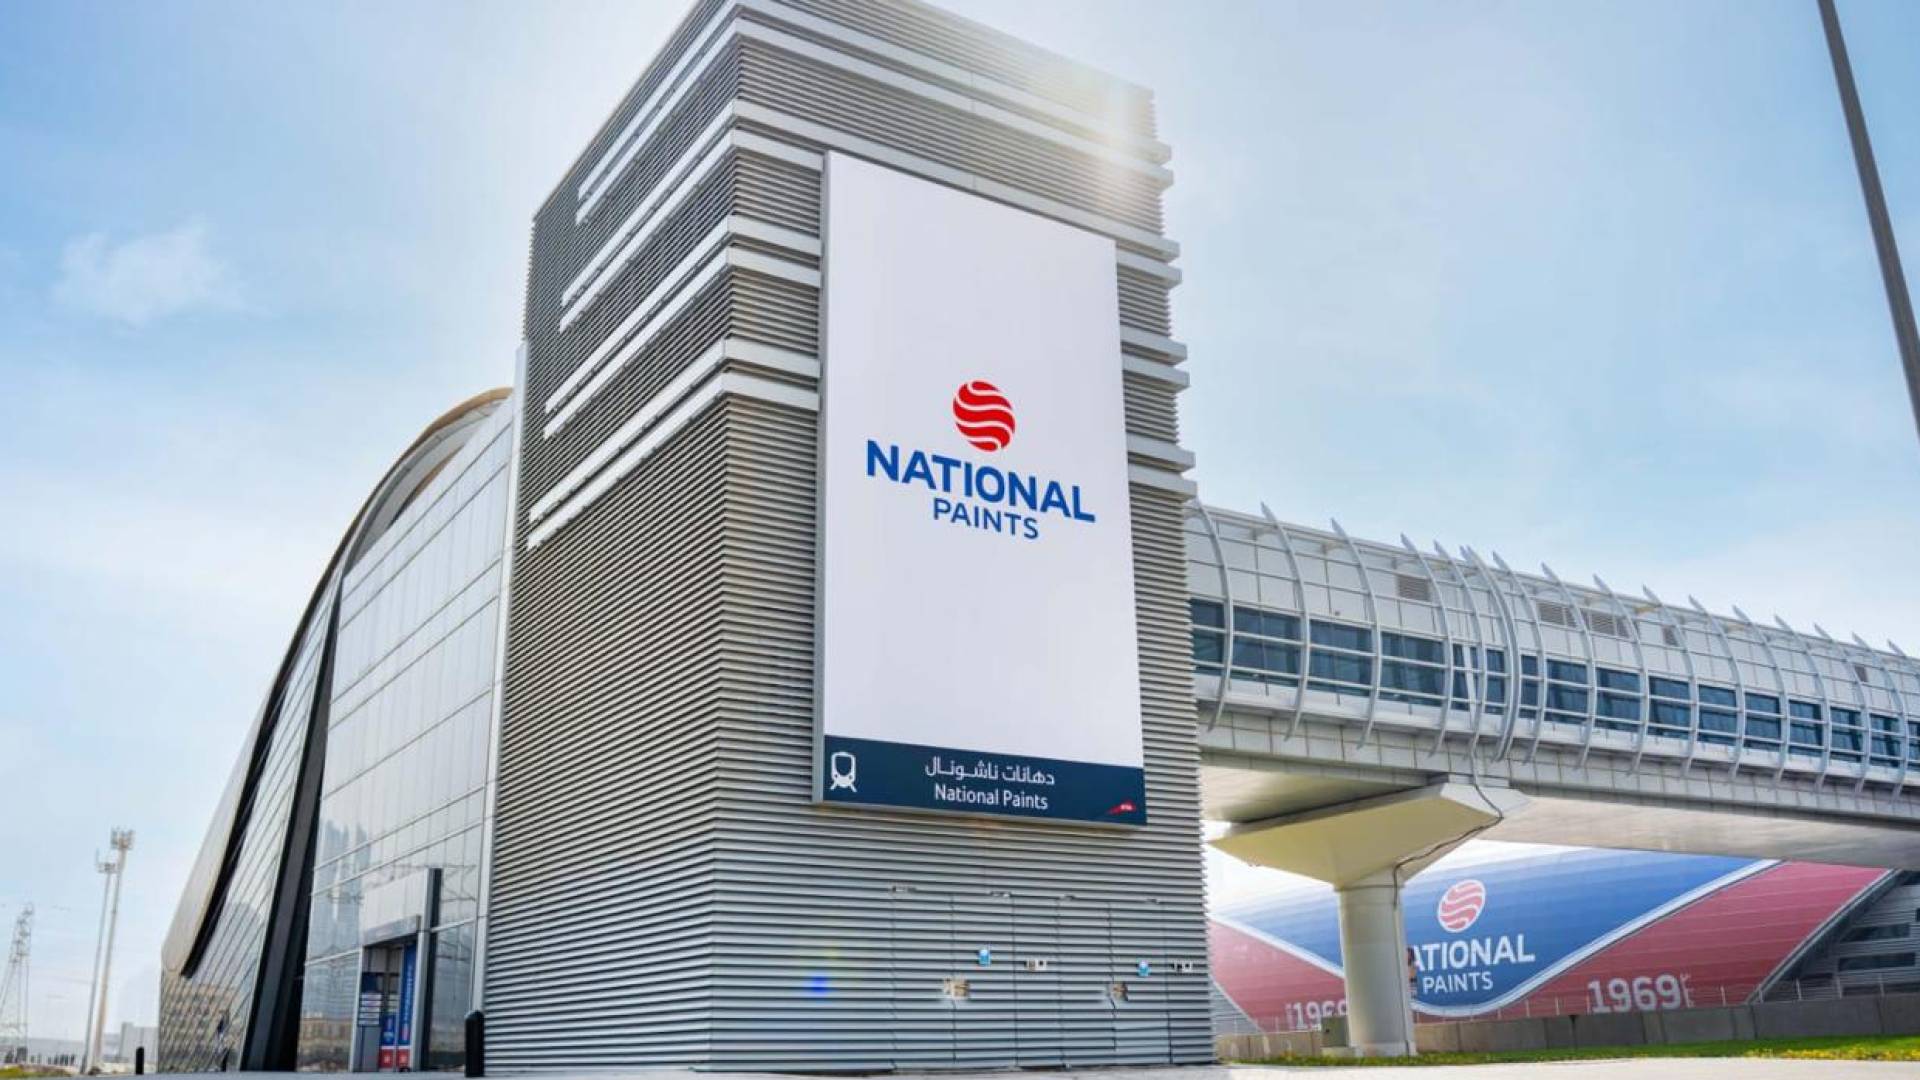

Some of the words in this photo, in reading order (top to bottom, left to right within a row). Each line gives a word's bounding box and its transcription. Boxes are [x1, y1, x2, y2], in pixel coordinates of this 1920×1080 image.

[867, 440, 1096, 523] NATIONAL
[933, 498, 1039, 540] PAINTS
[925, 756, 999, 780] ناشونال
[1002, 764, 1055, 785] دهانات
[935, 782, 999, 805] National
[1003, 789, 1048, 810] Paints
[1413, 933, 1536, 972] ATIONAL
[1423, 971, 1493, 995] PAINTS
[1587, 974, 1681, 1013] 1969
